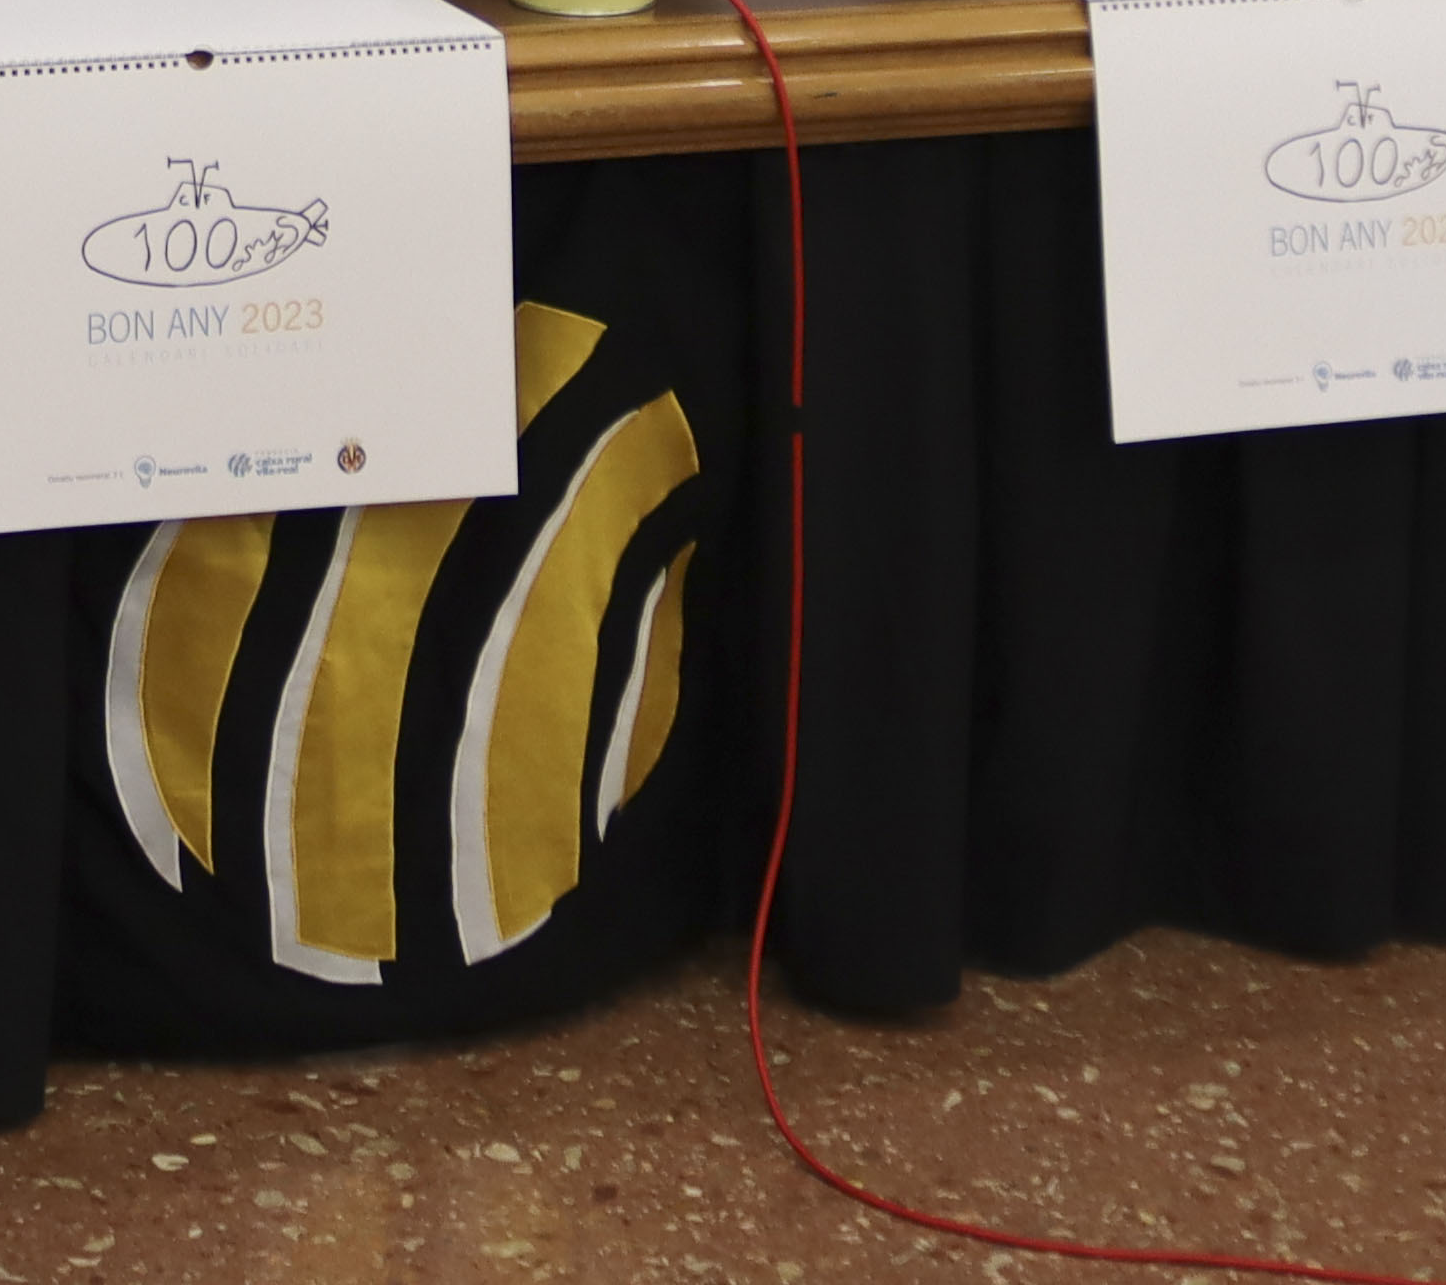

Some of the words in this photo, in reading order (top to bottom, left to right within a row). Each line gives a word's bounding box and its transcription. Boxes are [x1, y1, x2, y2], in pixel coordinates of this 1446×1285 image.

[1270, 224, 1329, 258] BON
[1339, 219, 1393, 252] ANY
[87, 310, 154, 345] BON
[167, 304, 230, 339] ANY
[241, 298, 324, 335] 2023
